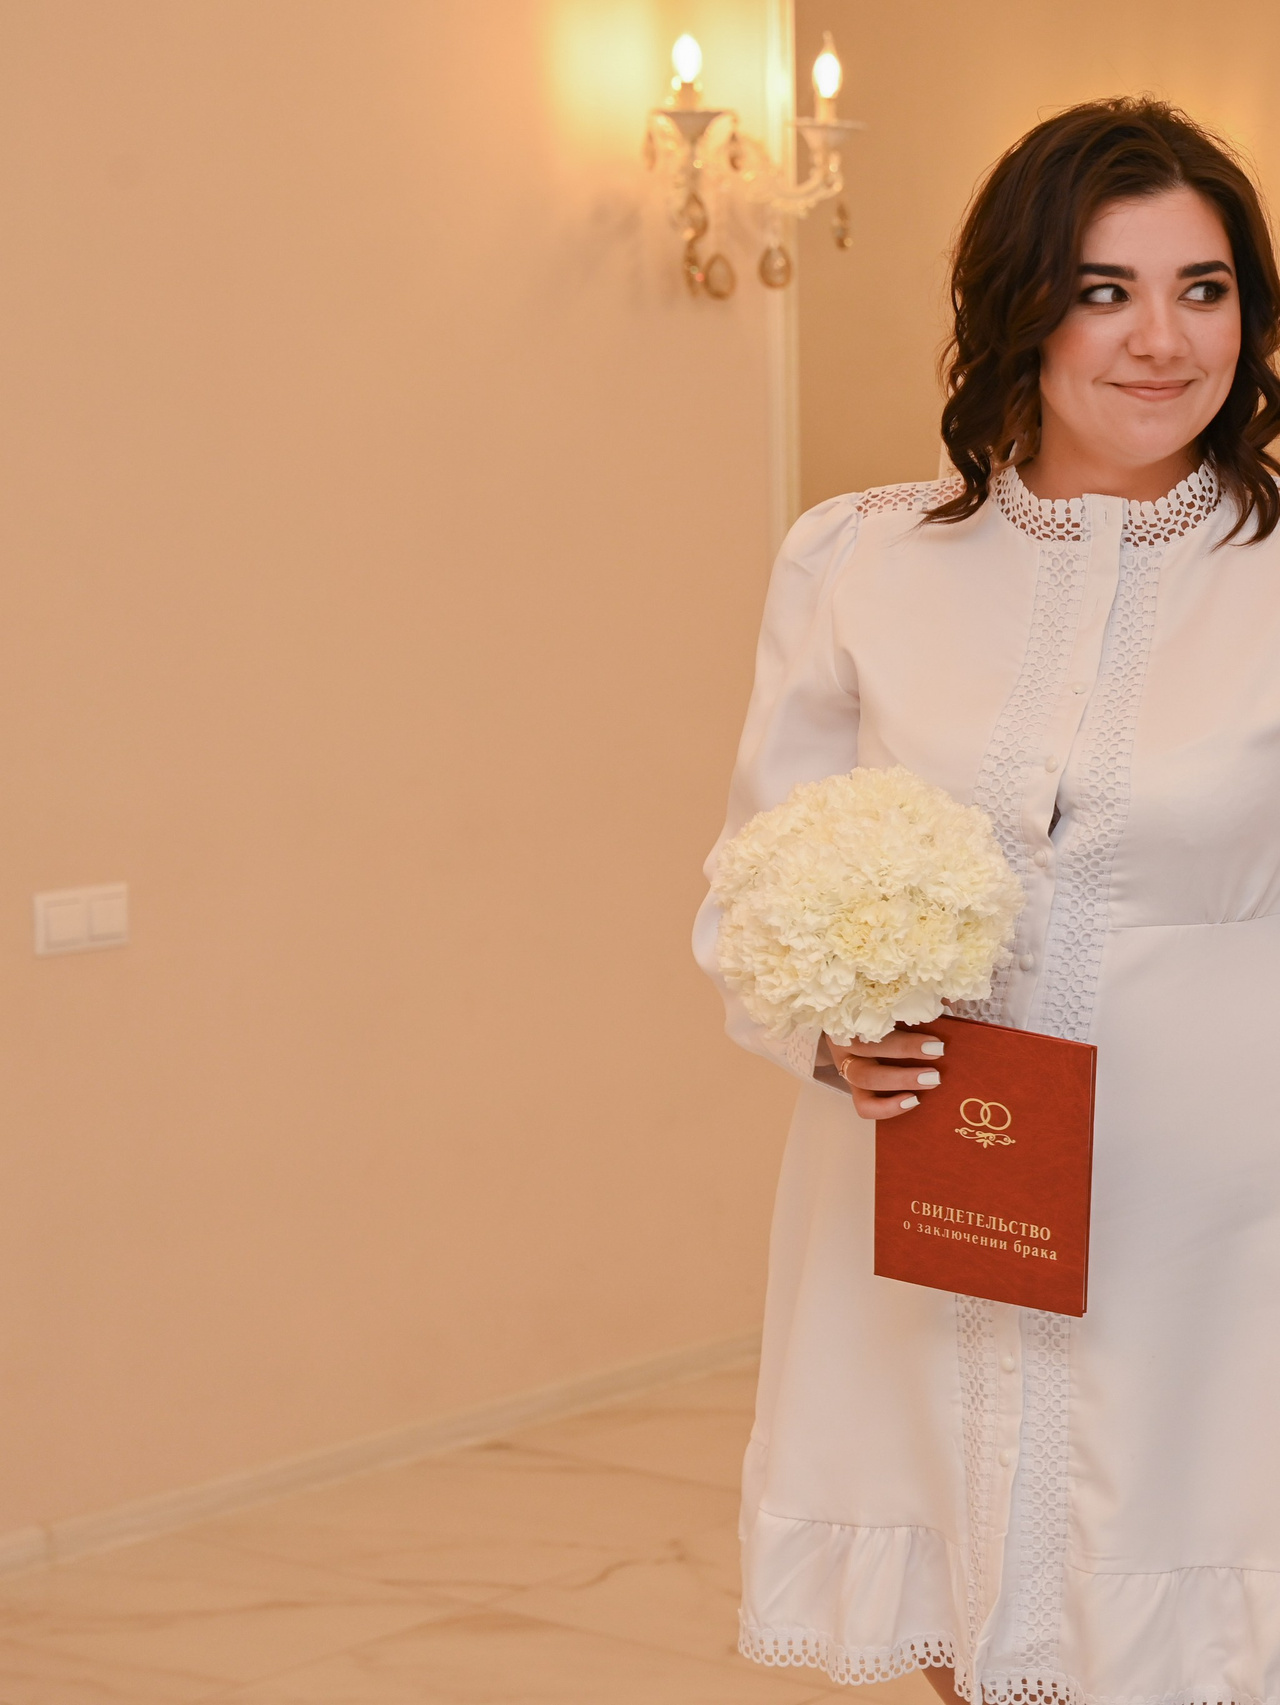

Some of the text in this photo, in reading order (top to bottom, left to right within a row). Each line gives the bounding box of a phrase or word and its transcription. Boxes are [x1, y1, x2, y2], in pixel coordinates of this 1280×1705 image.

[903, 1220, 1058, 1260] о заключении брака
[910, 1200, 1051, 1241] СВИДЕТЕЛЬСТВО
